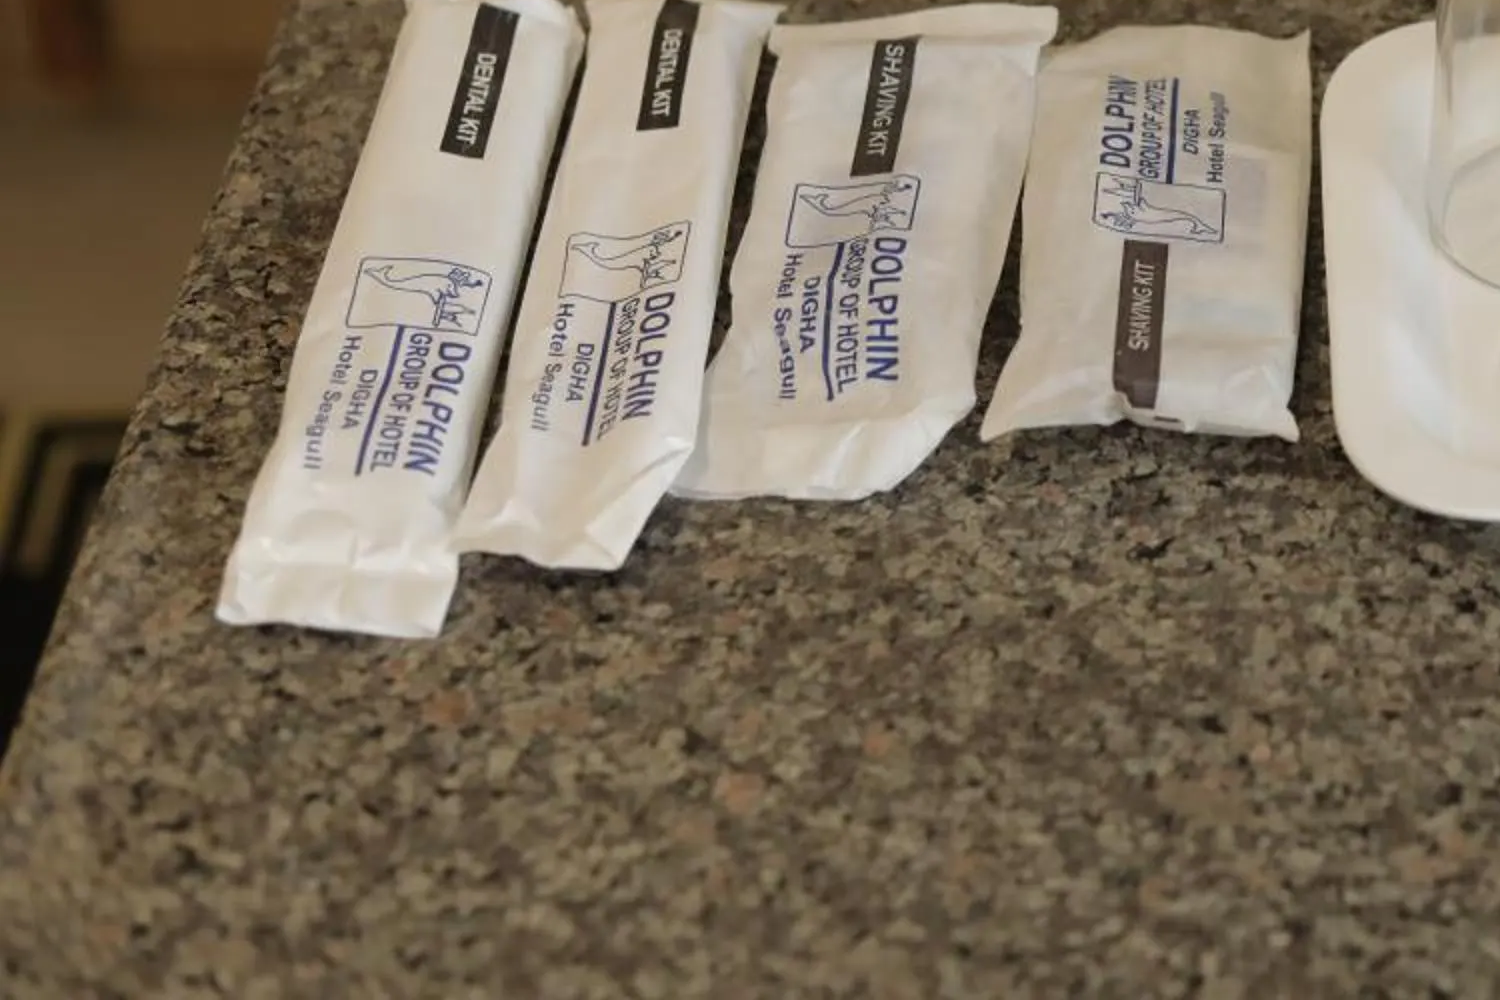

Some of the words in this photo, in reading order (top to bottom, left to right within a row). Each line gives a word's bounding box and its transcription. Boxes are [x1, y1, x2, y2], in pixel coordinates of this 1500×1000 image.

[464, 52, 498, 115] DENTAL
[654, 27, 683, 87] DENTAL
[871, 43, 906, 129] SHAVING
[455, 117, 482, 147] KIT
[651, 87, 673, 118] KIT
[865, 130, 889, 157] KIT
[1206, 143, 1226, 184] Hotel
[776, 252, 804, 299] Hotel
[1133, 259, 1156, 288] KIT
[547, 302, 577, 358] Hotel
[799, 275, 821, 353] DIGHA
[838, 293, 861, 319] OF
[865, 236, 908, 381] DOLPHIN
[1127, 287, 1153, 352] SHAVING
[328, 334, 364, 386] Hotel
[399, 332, 434, 391] GROUP
[564, 342, 596, 402] DIGHA
[621, 291, 677, 422] DOLPHIN
[835, 323, 860, 394] HOTEL
[340, 368, 379, 430] DIGHA
[388, 392, 416, 414] OF
[402, 340, 473, 478] DOLPHIN
[530, 362, 563, 432] Seagull
[302, 390, 343, 471] Seagull
[369, 414, 409, 473] HOTEL
